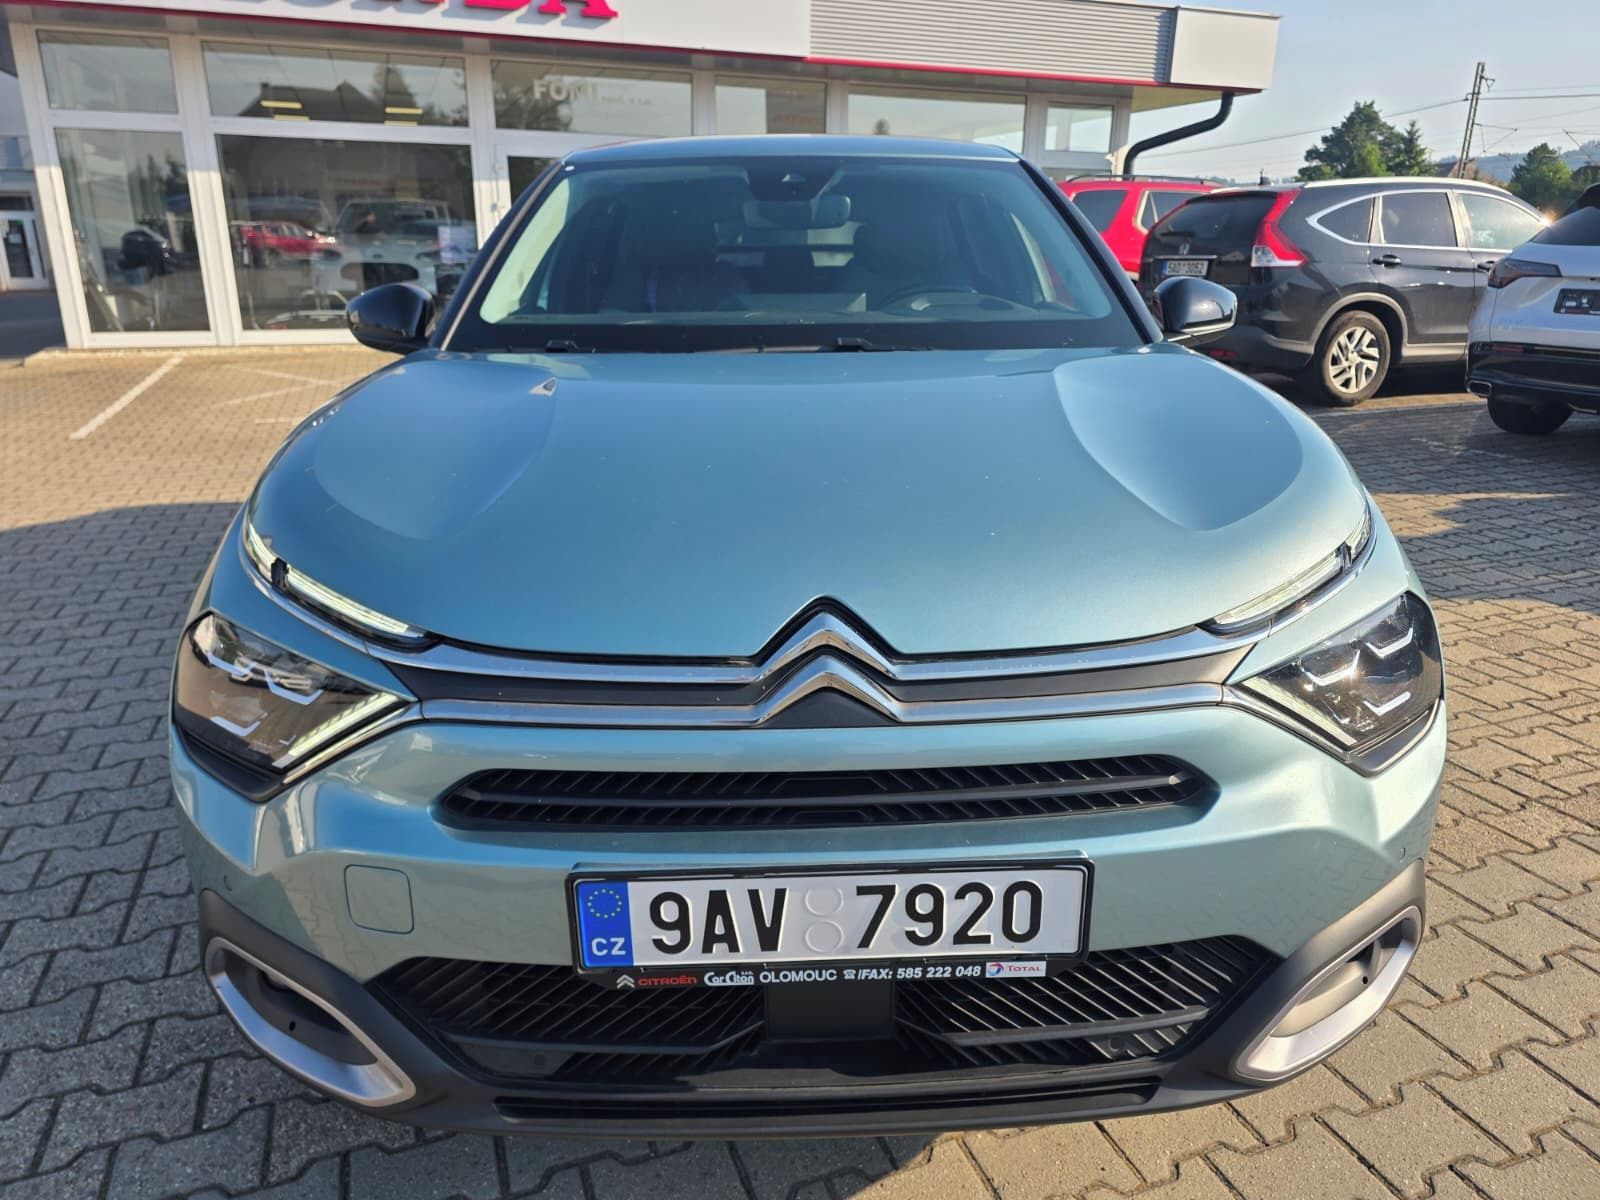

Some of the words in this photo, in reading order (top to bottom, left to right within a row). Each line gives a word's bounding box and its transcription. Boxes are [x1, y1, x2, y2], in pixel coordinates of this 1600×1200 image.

[649, 888, 789, 954] 9AV
[856, 880, 1043, 949] 7920
[591, 937, 626, 956] CZ
[638, 974, 697, 986] CITROËN
[759, 969, 838, 984] OLOMOUC
[897, 967, 922, 979] 585
[926, 966, 951, 978] 222
[955, 965, 982, 978] 048
[1007, 964, 1040, 973] TOTAL
